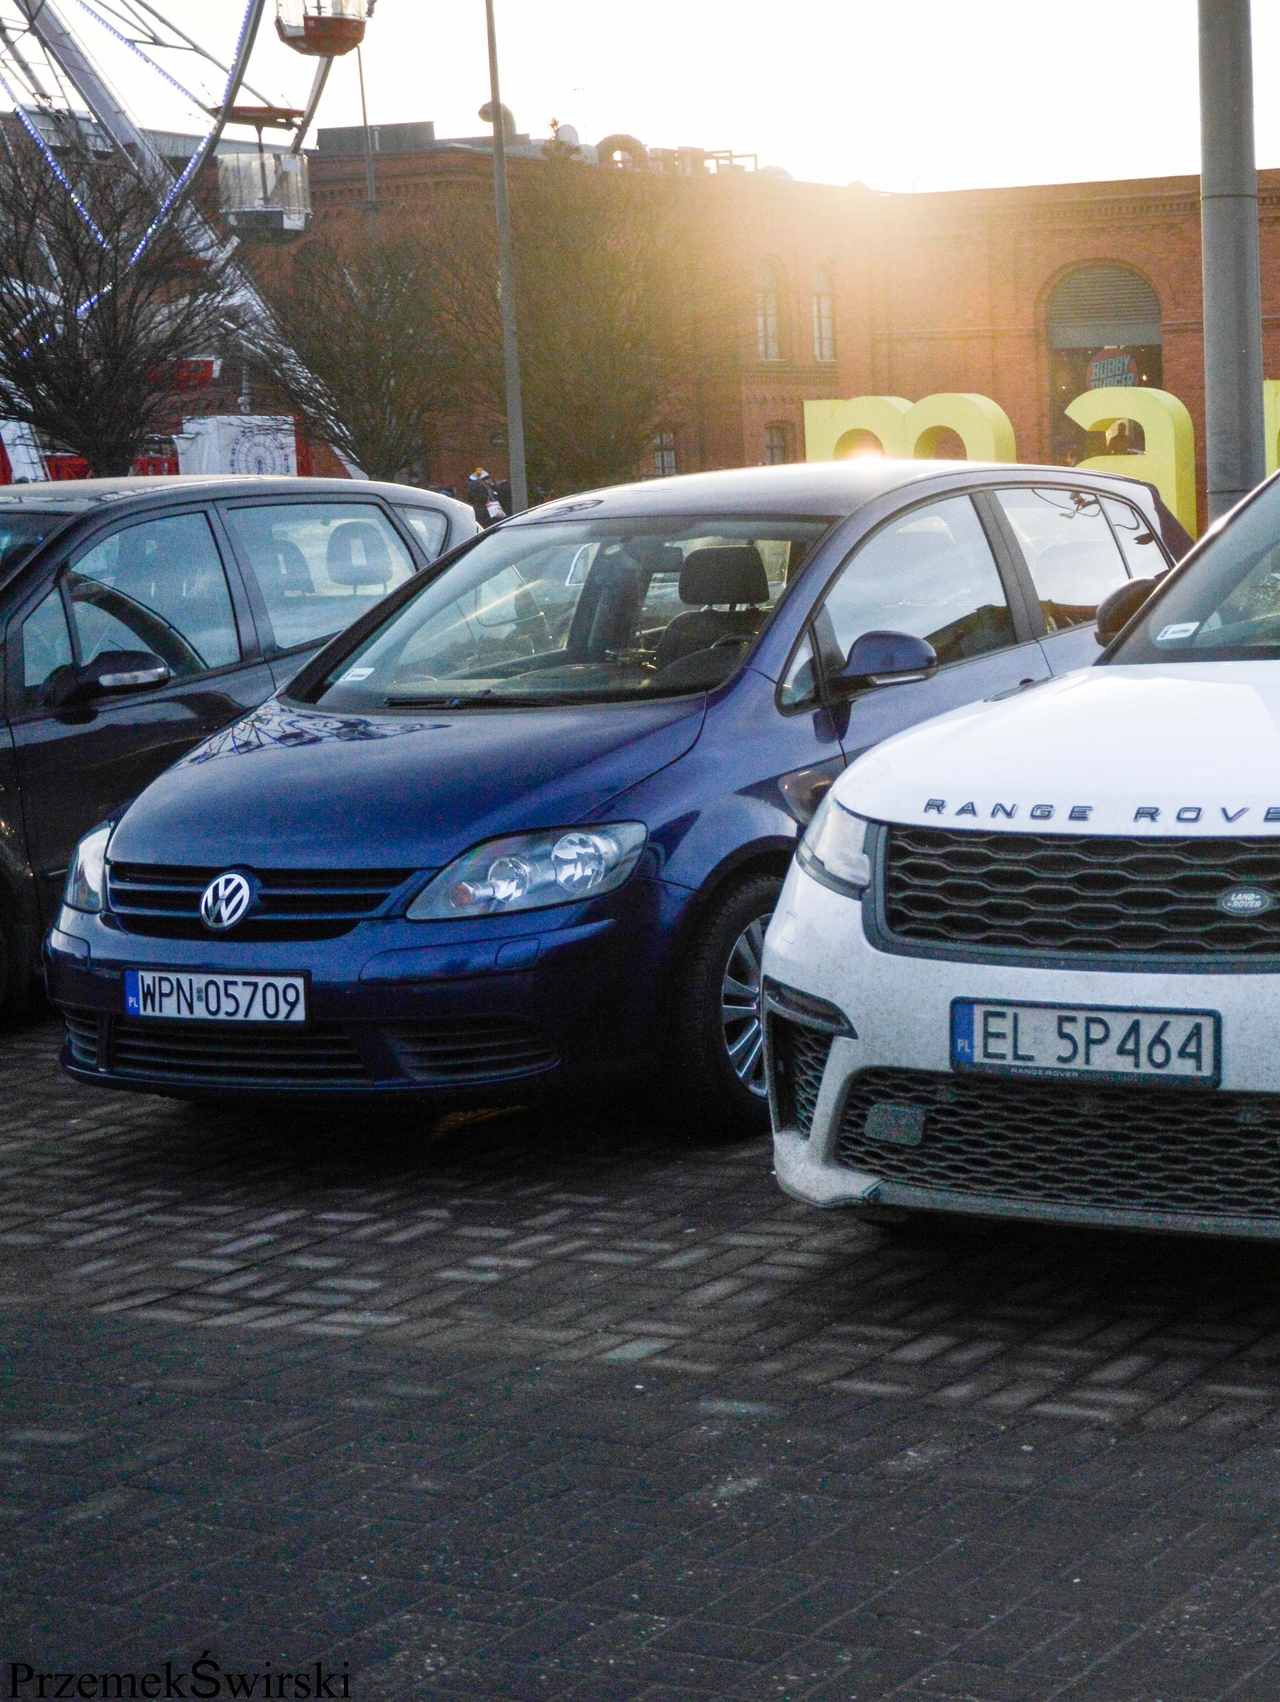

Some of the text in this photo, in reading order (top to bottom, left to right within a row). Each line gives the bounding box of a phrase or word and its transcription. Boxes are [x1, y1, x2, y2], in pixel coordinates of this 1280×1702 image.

[1090, 354, 1131, 380] BOBBY
[923, 798, 1094, 821] RANGE
[128, 997, 139, 1008] PL
[140, 974, 301, 1020] WPN 05709
[957, 1038, 971, 1053] PL
[982, 1009, 1203, 1072] EL 5P464
[1010, 1067, 1044, 1076] RANGE
[1045, 1070, 1079, 1078] ROVER
